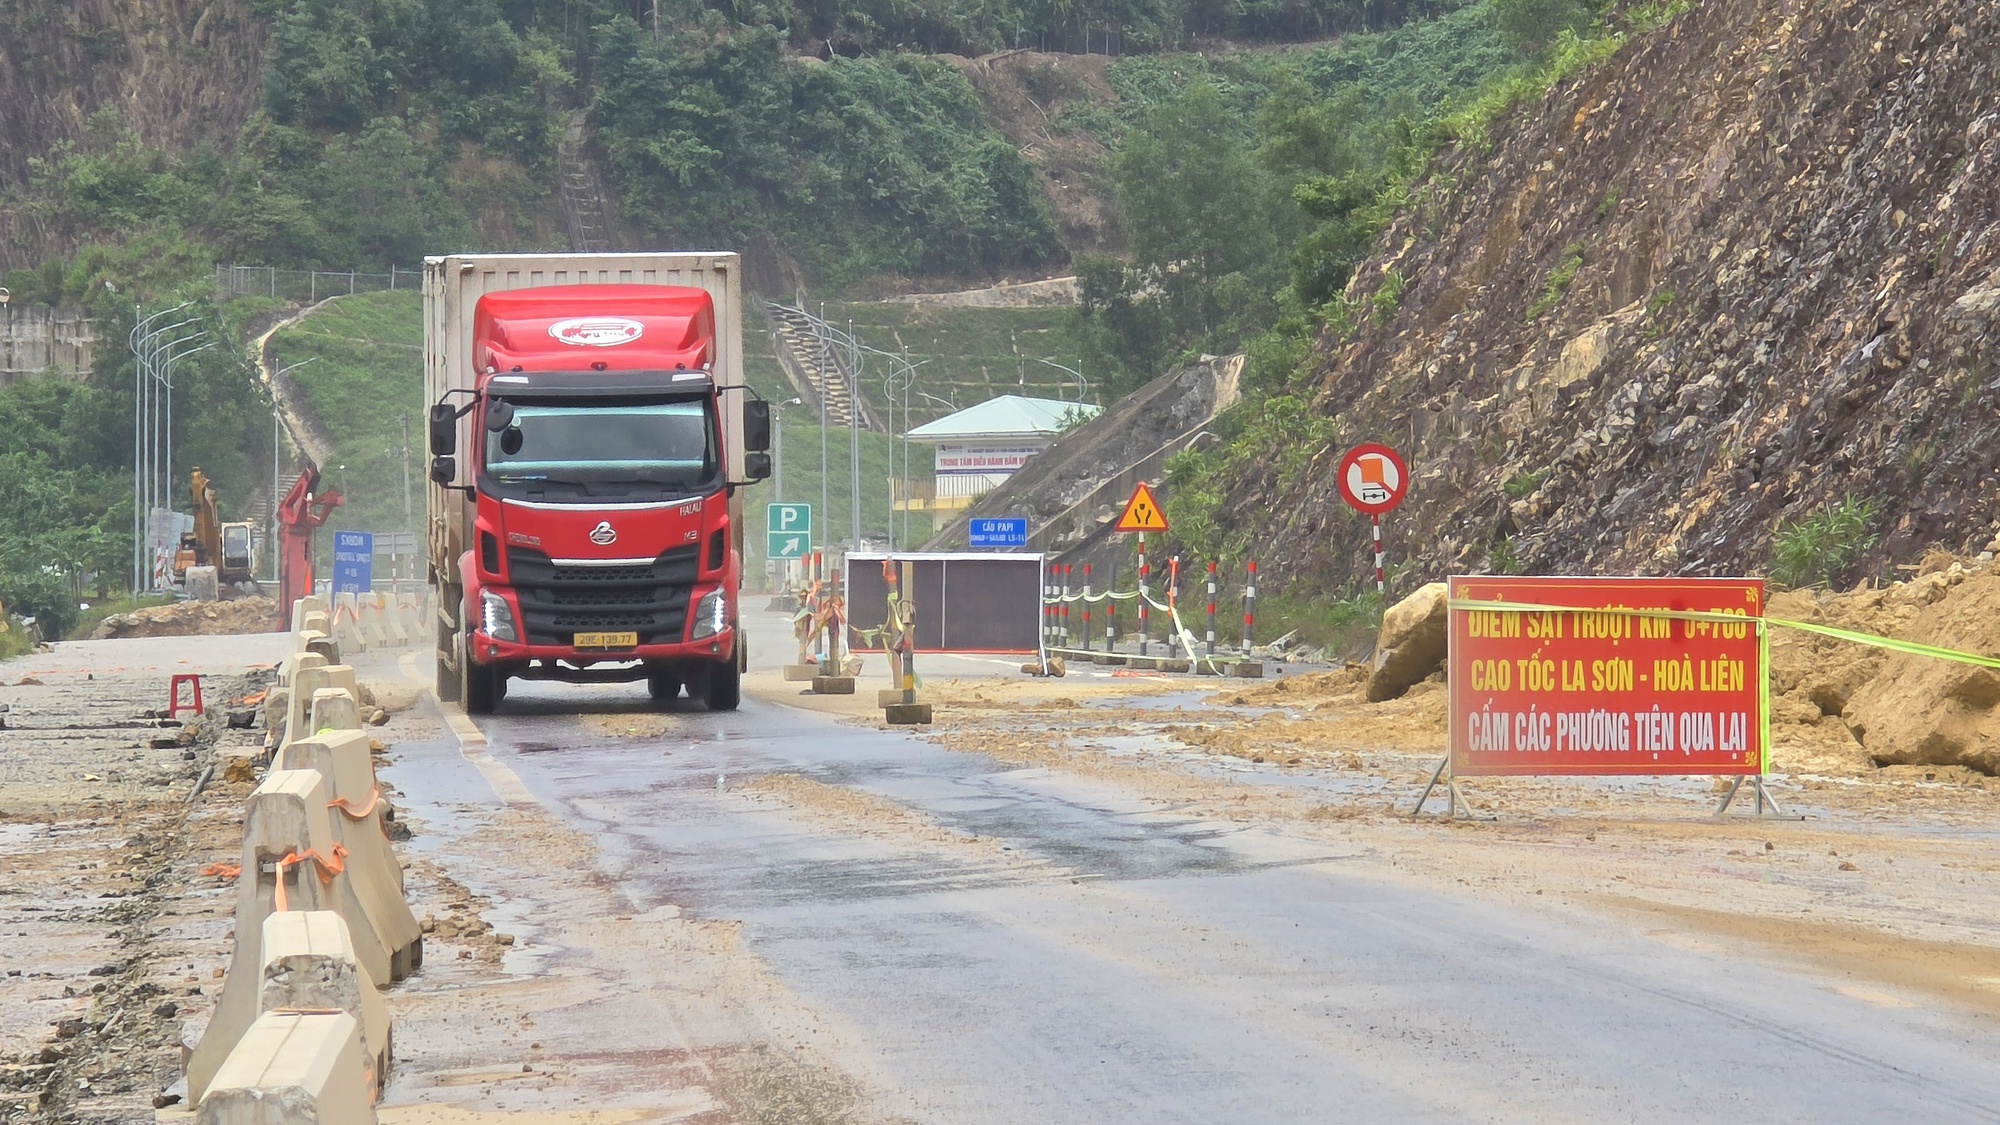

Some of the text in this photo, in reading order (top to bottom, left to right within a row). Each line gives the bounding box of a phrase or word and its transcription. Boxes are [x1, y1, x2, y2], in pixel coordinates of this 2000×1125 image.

[781, 507, 798, 530] P
[1468, 593, 1520, 638] ĐIỂM
[1573, 604, 1634, 646] TRƯỢT
[1640, 607, 1670, 638] KM
[1472, 660, 1510, 691] CAO
[1517, 648, 1554, 691] TỐC
[1562, 660, 1586, 691] LA
[1592, 656, 1633, 691] SƠN
[1654, 653, 1694, 691] HOÀ
[1700, 654, 1744, 691] LIÊN
[1468, 698, 1746, 760] CẤM CÁC PHƯƠNG TIỆN QUA LẠI
